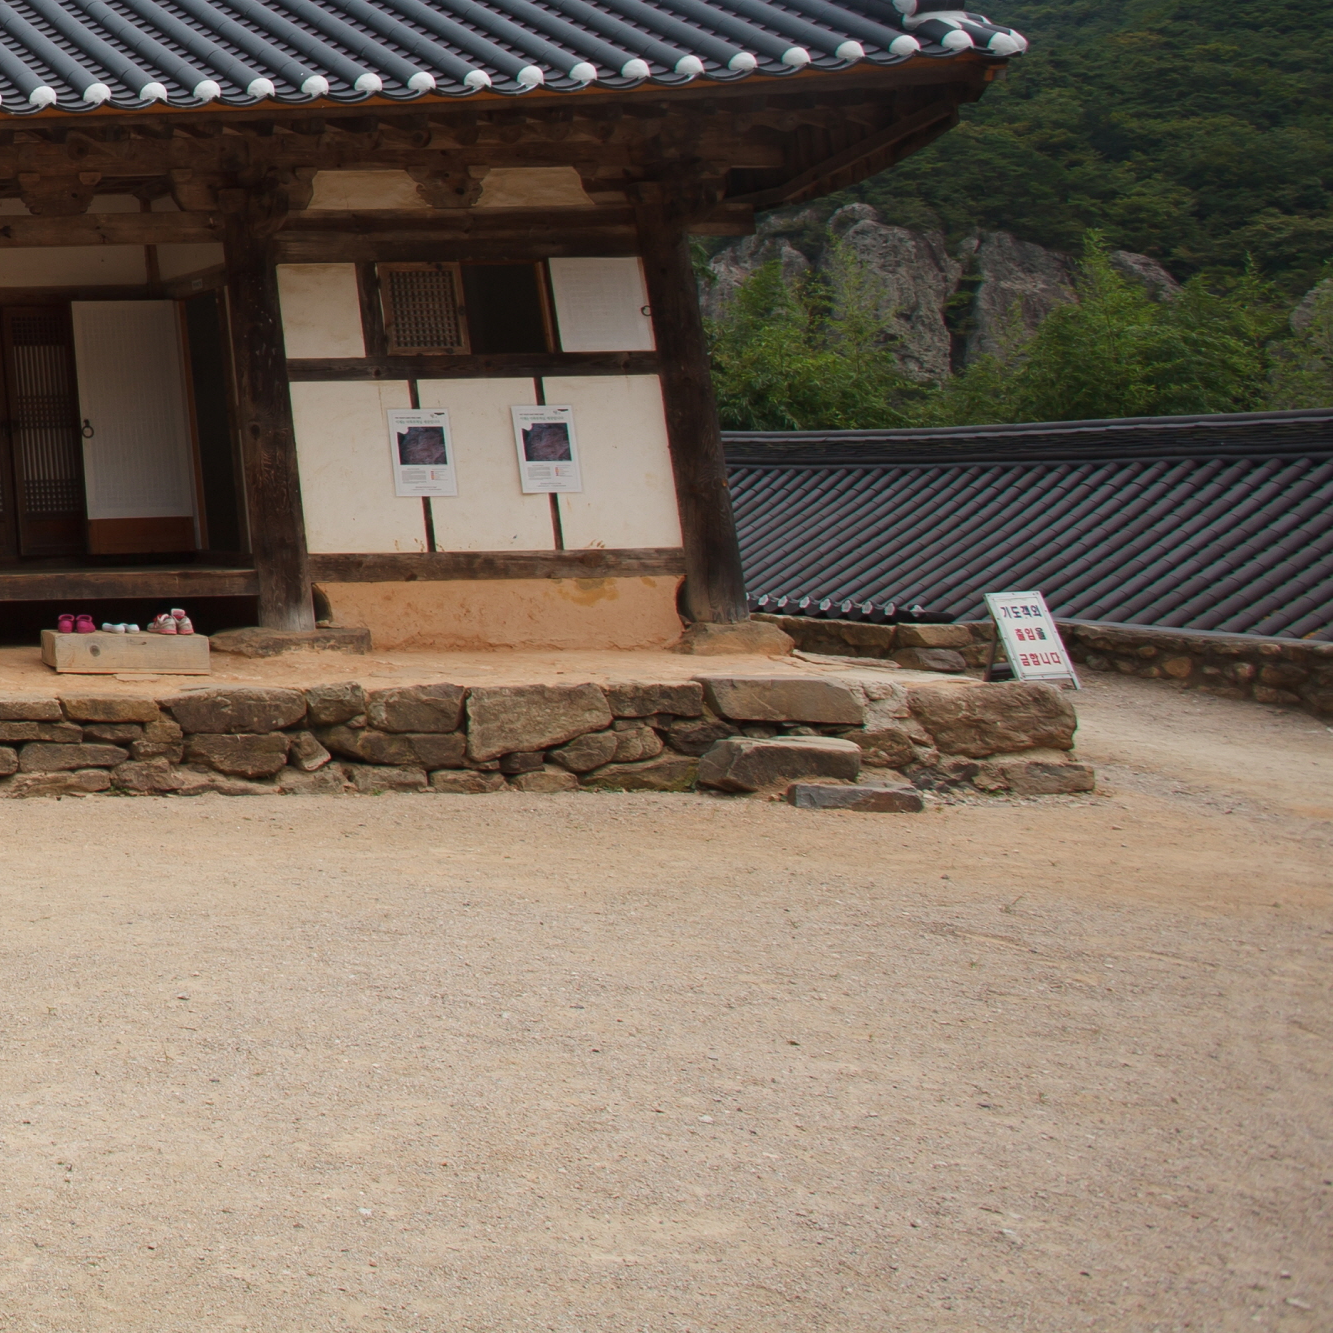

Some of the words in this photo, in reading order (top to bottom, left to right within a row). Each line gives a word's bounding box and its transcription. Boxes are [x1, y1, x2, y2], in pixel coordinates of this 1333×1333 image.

[1000, 604, 1043, 619] 기도객외
[1014, 627, 1047, 642] 출입을
[1019, 651, 1062, 667] 금합니다
